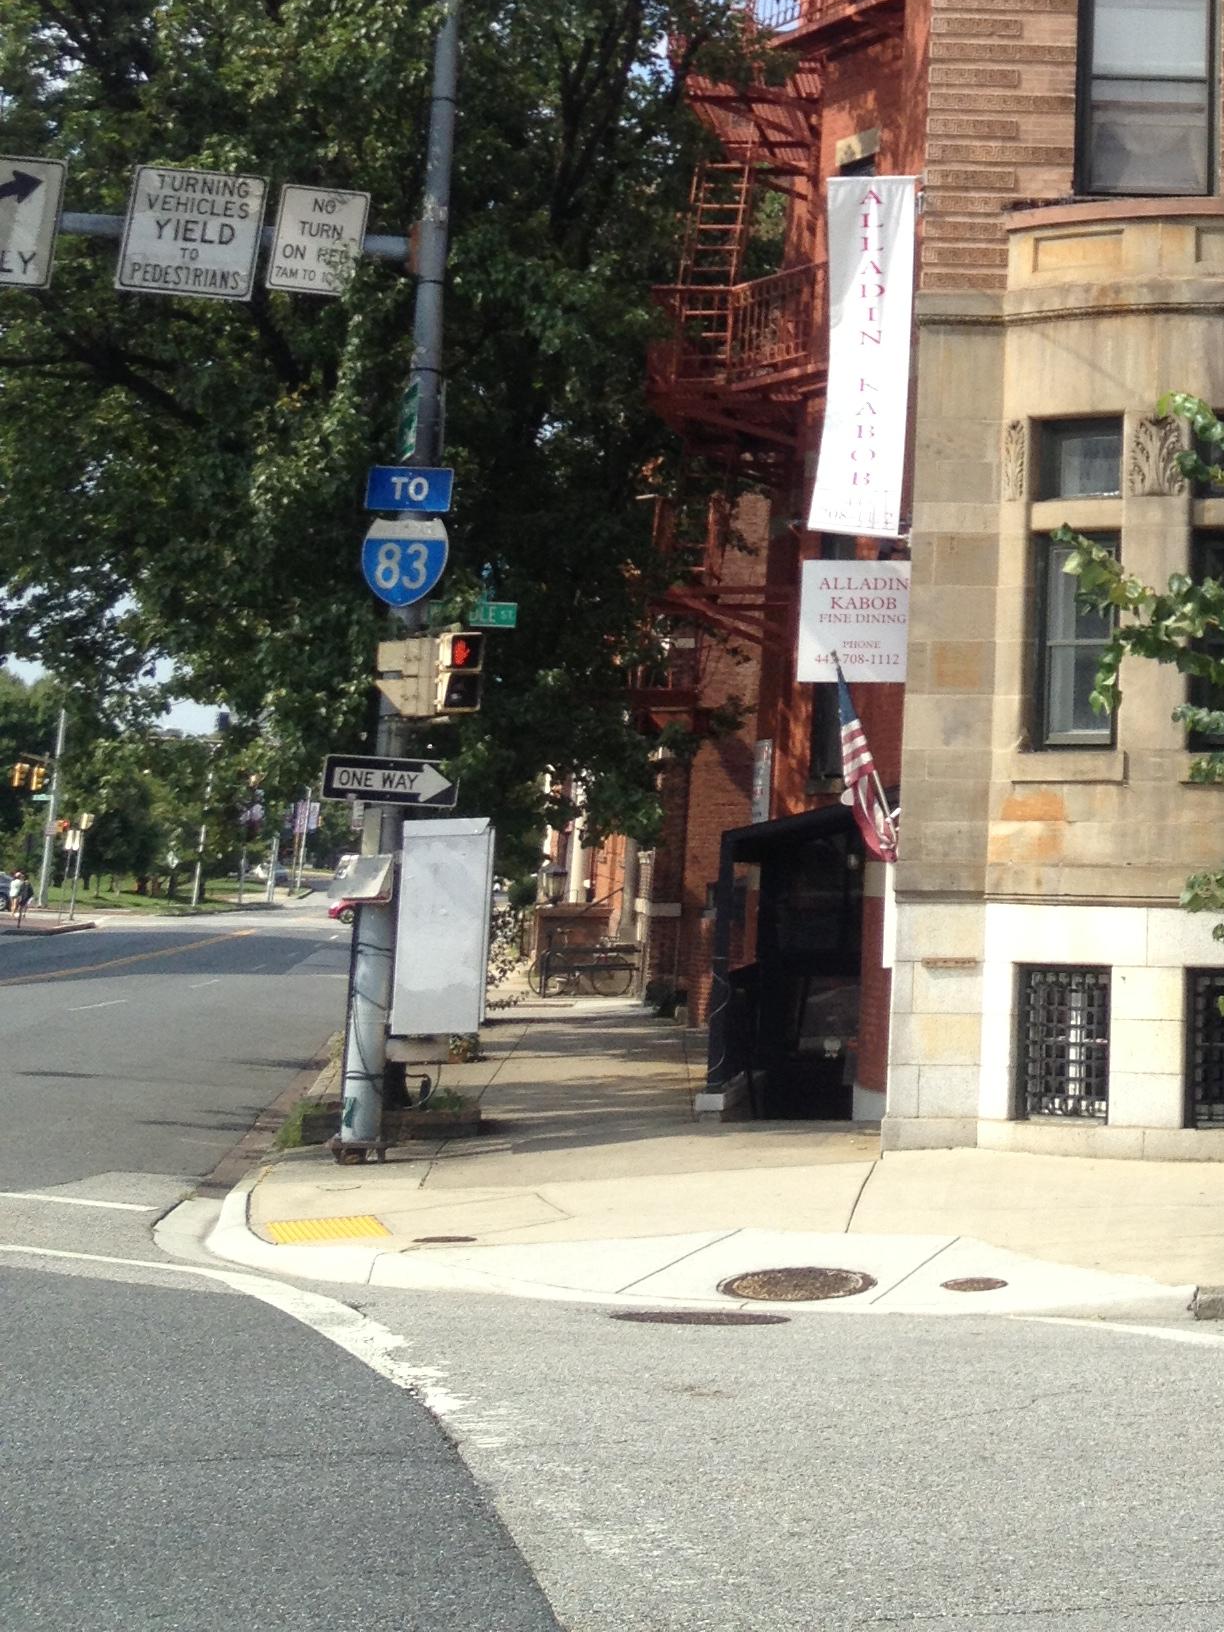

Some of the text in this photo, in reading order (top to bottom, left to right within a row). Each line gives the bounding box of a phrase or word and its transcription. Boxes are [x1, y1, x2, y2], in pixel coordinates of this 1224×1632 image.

[157, 173, 249, 199] TURNING
[147, 193, 250, 219] VEHICLES
[312, 197, 336, 214] NO
[156, 218, 235, 245] YIELD
[299, 220, 343, 241] TURN
[180, 248, 200, 261] TO
[282, 243, 306, 260] ON
[130, 262, 240, 290] PEDESTRIANS
[275, 266, 298, 278] 7AM
[301, 269, 316, 281] TO
[859, 189, 886, 345] ALLADIN
[850, 377, 879, 486] KABOB
[391, 476, 429, 501] TO
[375, 542, 428, 589] 83
[819, 577, 911, 591] ALLADIN
[831, 597, 897, 610] KABOB
[819, 613, 907, 625] FINE DINING
[843, 640, 880, 649] PHONE
[339, 770, 418, 790] ONE WAY
